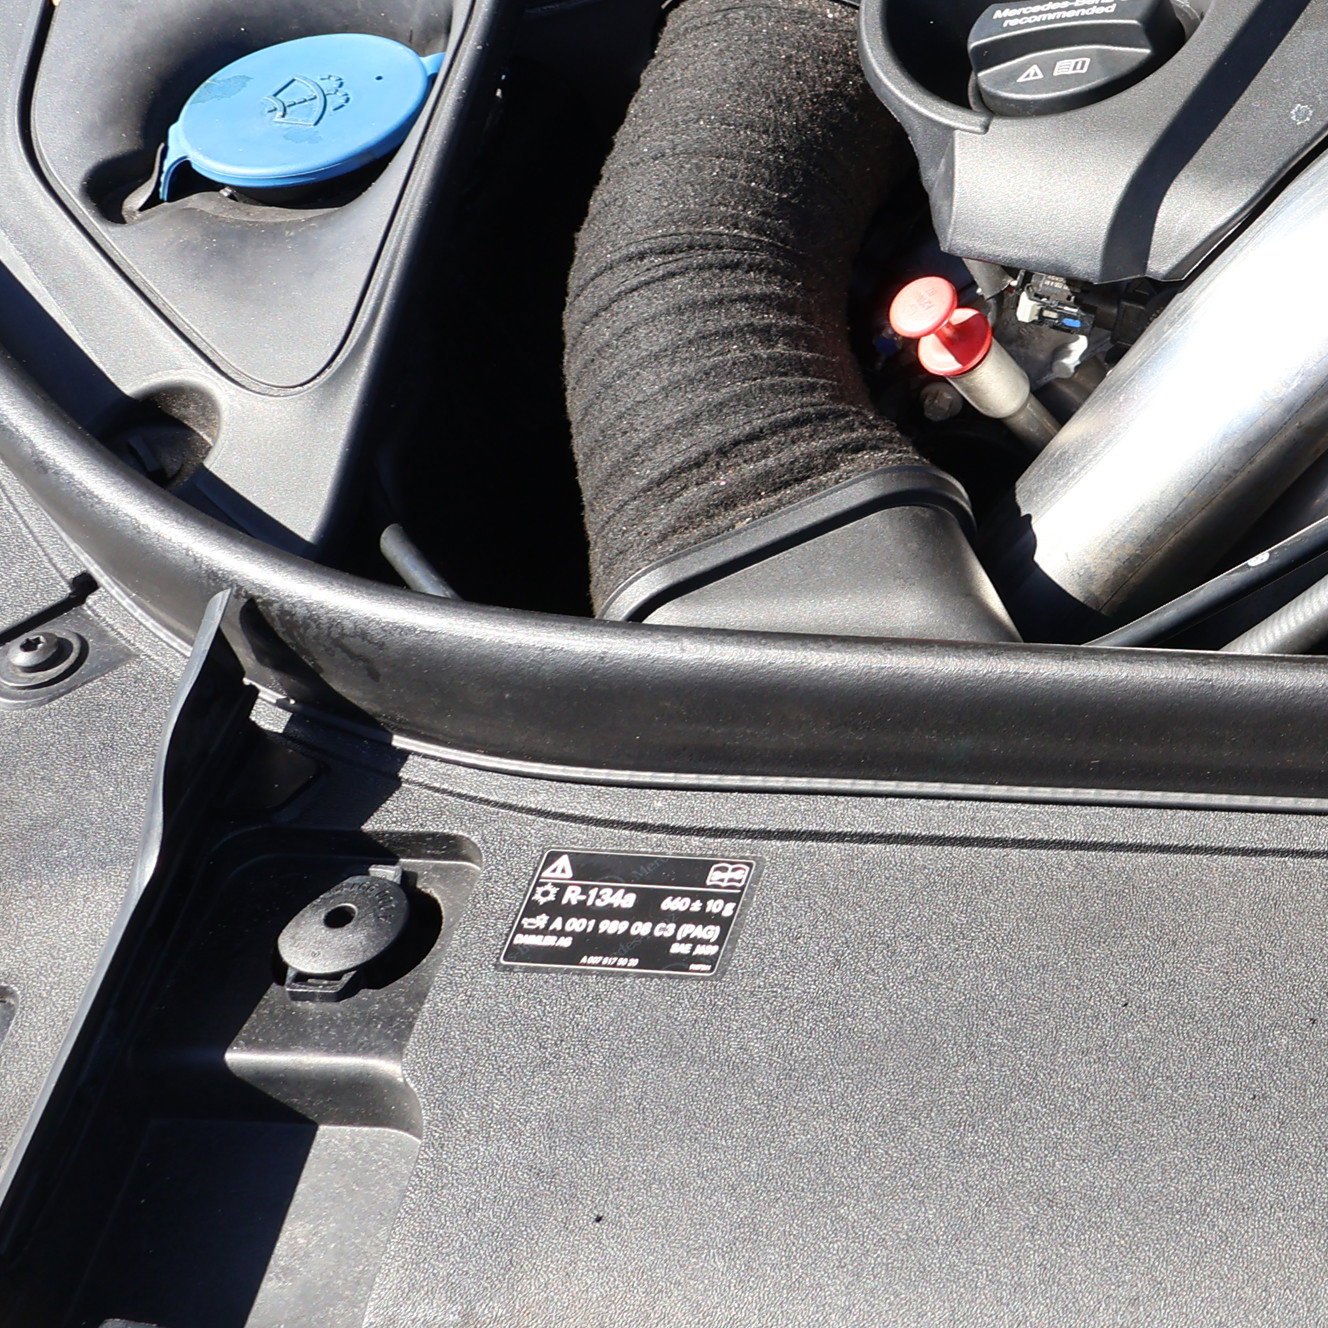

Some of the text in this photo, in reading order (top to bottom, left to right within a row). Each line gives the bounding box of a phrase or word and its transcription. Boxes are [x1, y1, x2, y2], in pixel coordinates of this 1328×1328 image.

[1002, 3, 1116, 28] recommended
[561, 886, 637, 909] R-134a
[660, 896, 689, 911] 660
[705, 900, 721, 913] 10
[721, 902, 736, 917] g
[549, 918, 562, 930] A
[565, 918, 594, 932] 001
[598, 920, 630, 934] 989
[630, 922, 652, 936] 08
[676, 925, 720, 942] (PAG)
[555, 936, 573, 948] AG
